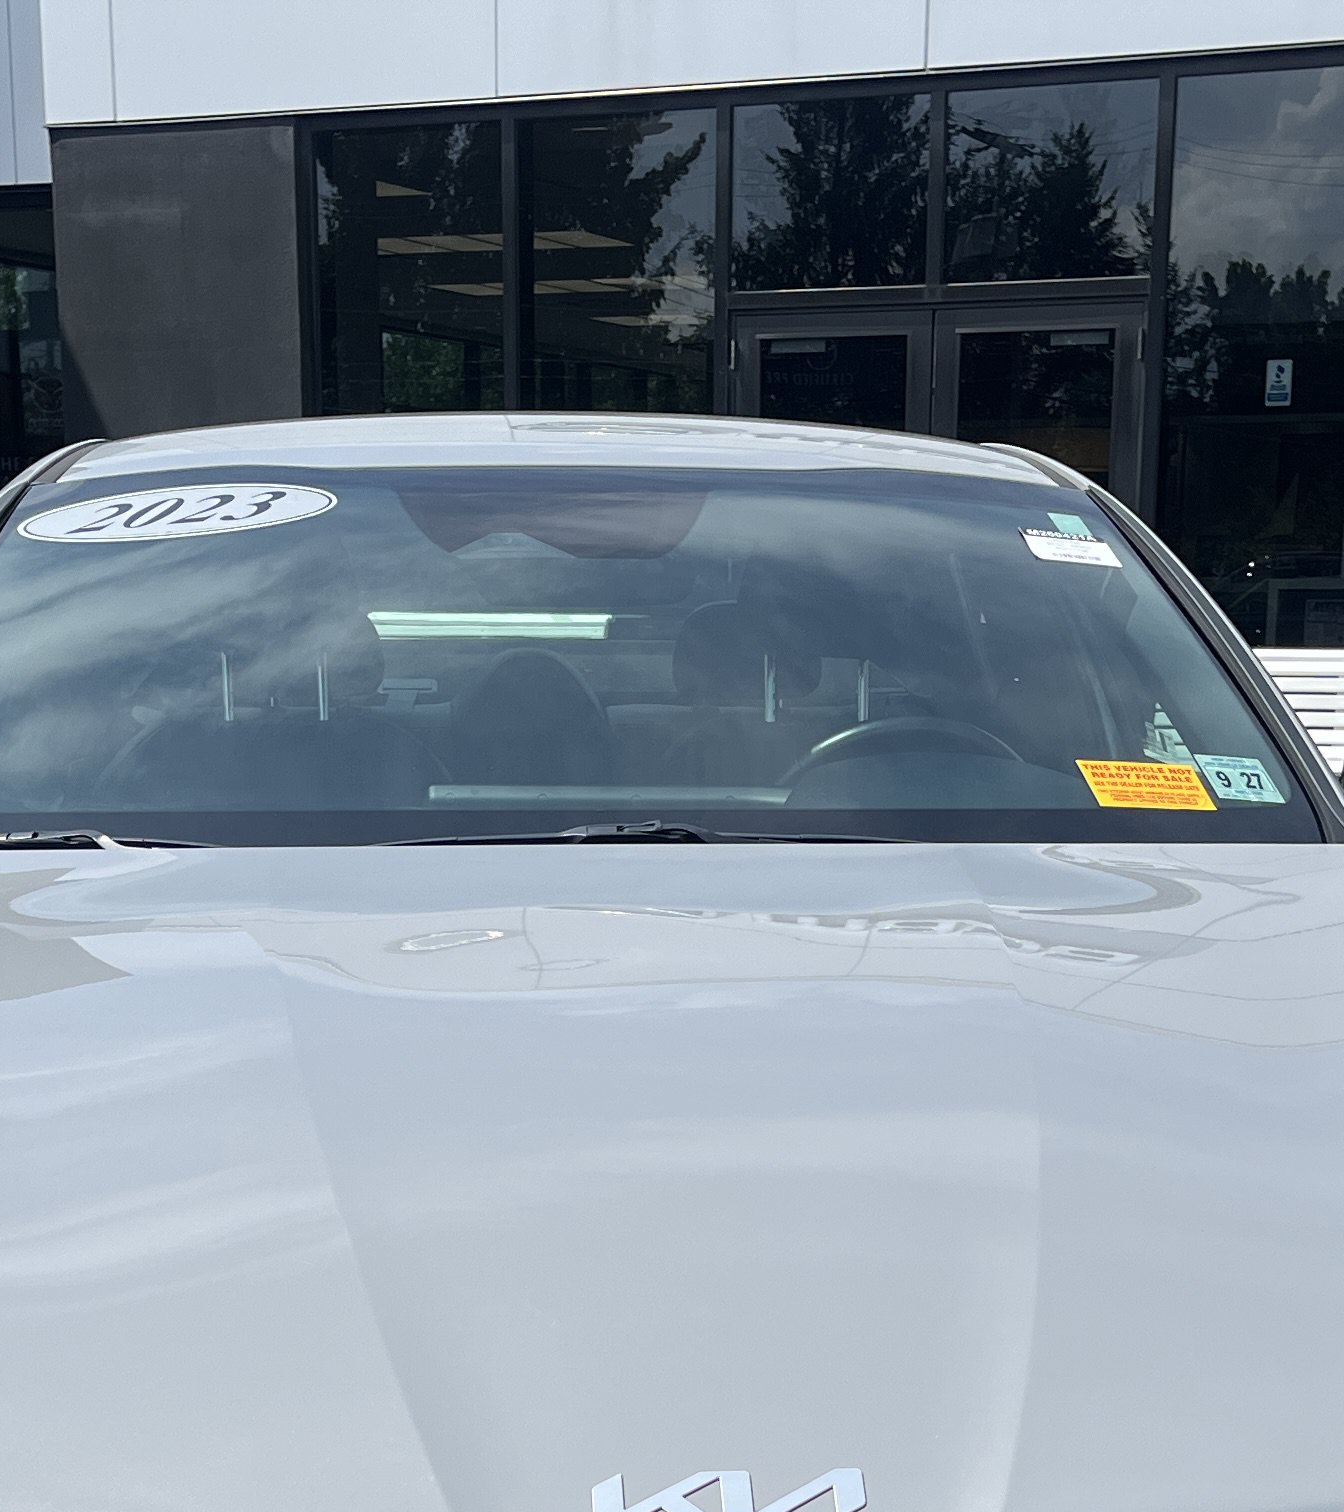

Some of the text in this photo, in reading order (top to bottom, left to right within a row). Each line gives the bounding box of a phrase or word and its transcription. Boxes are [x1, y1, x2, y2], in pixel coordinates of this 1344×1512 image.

[64, 491, 288, 536] 2023
[1216, 770, 1264, 790] 9 27
